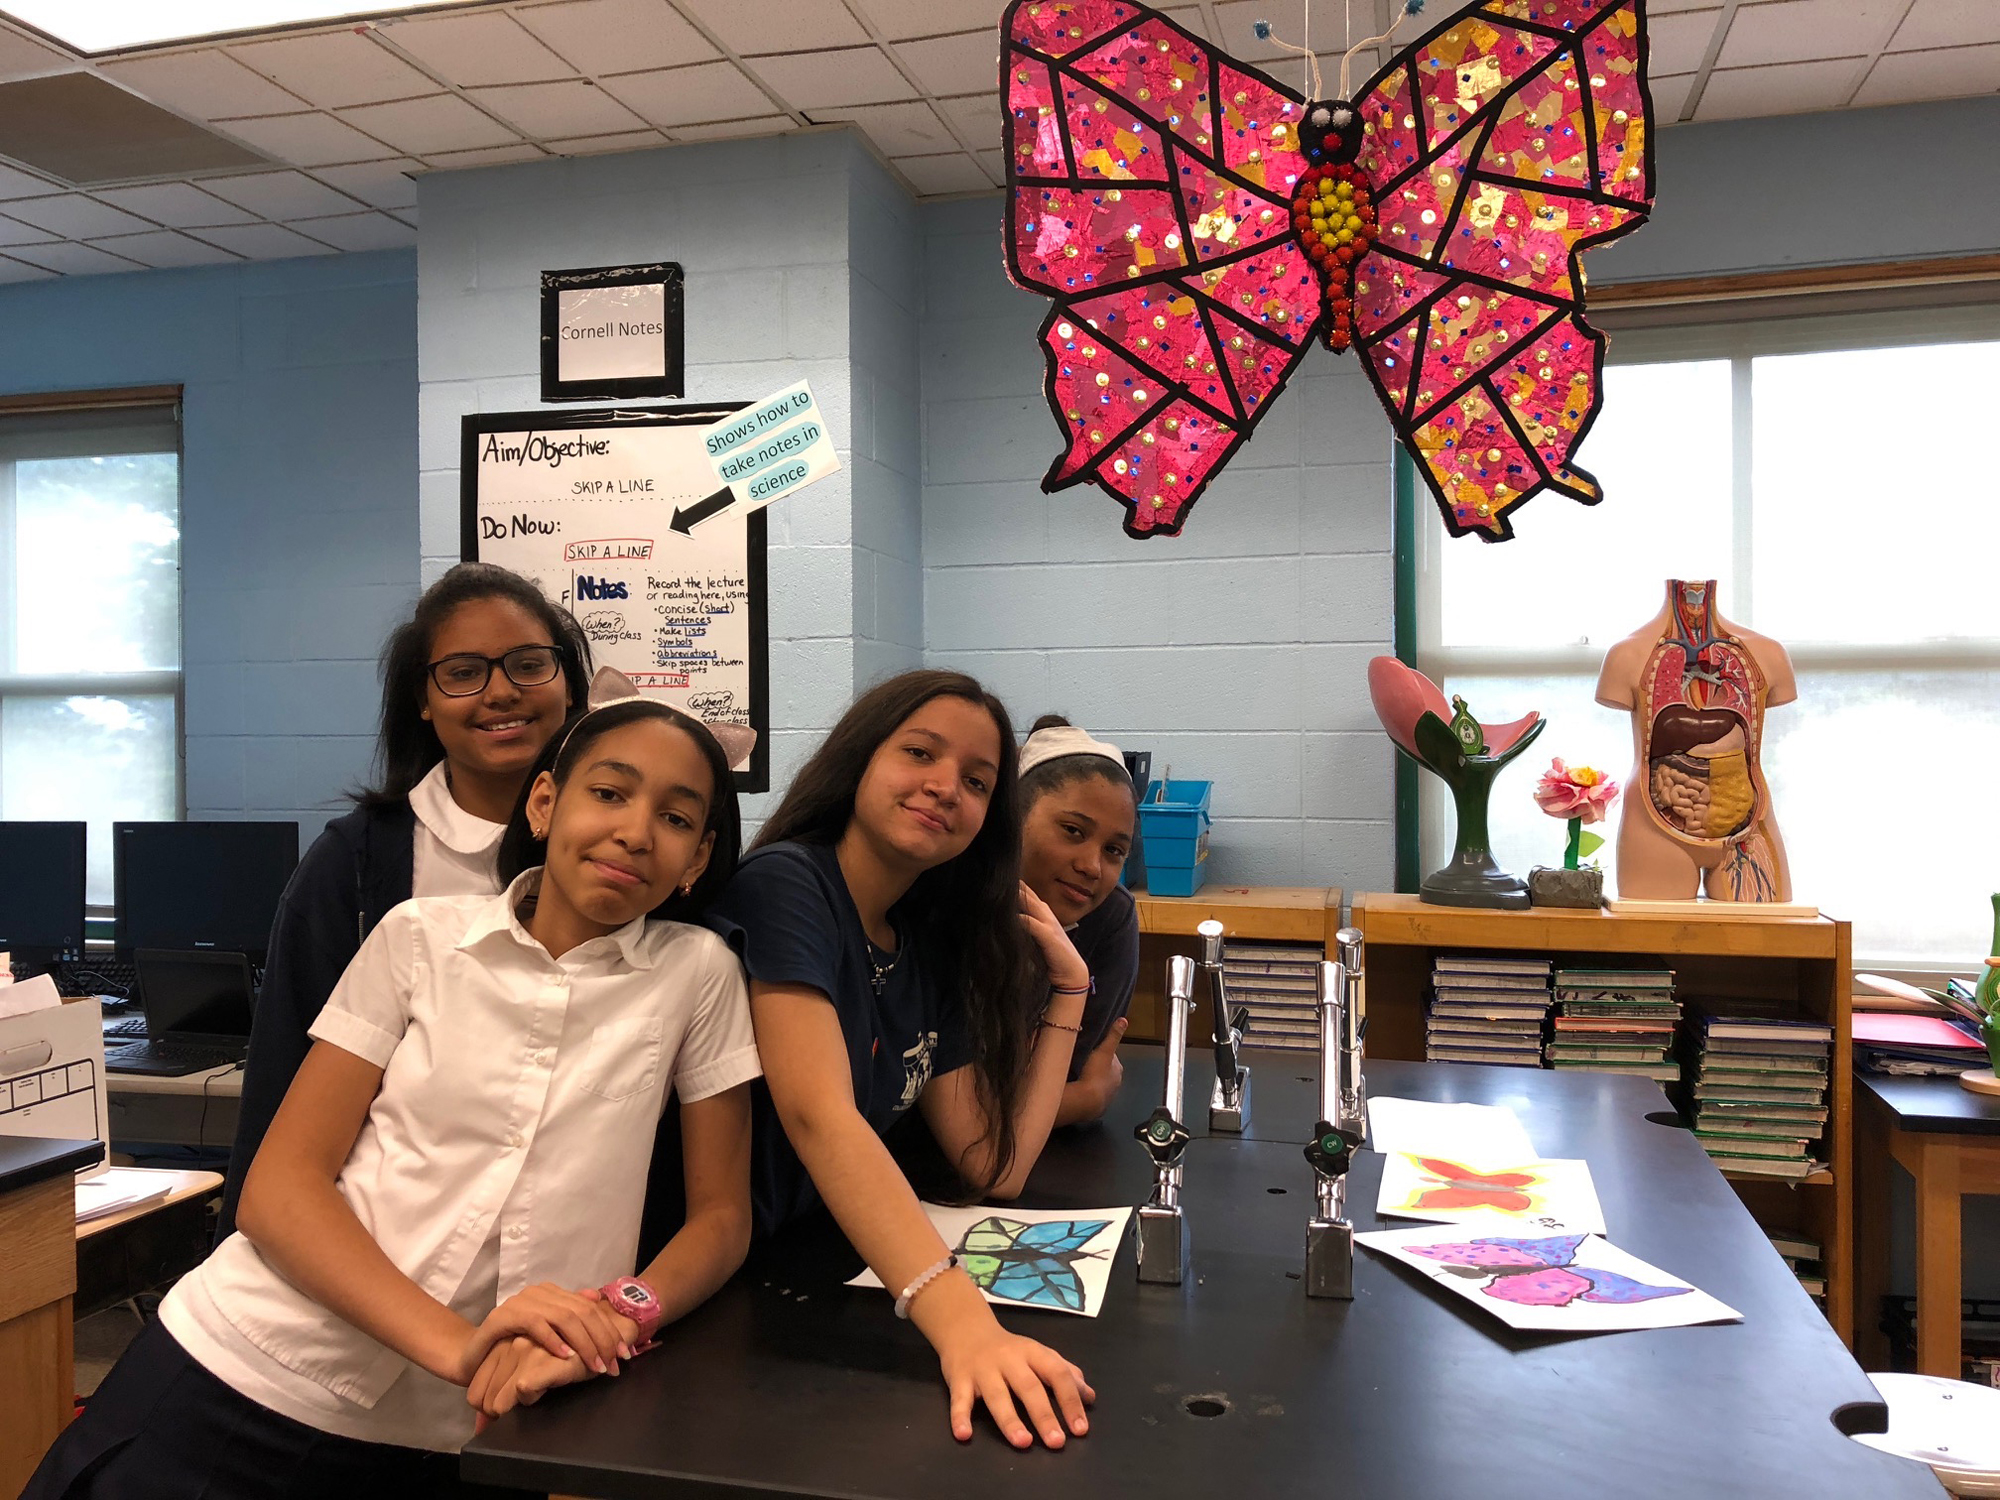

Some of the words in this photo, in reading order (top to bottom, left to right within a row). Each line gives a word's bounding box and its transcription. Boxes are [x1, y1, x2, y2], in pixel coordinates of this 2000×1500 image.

[561, 322, 613, 340] Cornell
[619, 321, 663, 336] Notes
[706, 421, 756, 454] Shows
[755, 401, 790, 427] how
[791, 391, 809, 408] to
[482, 431, 610, 468] Aim/Objective:
[721, 456, 756, 479] take
[758, 433, 801, 462] notes
[801, 426, 819, 441] in
[571, 480, 603, 494] SKIP
[606, 480, 614, 493] A
[618, 478, 655, 494] LINE
[750, 465, 806, 498] science
[480, 516, 507, 539] Do
[511, 513, 561, 538] Now:
[568, 544, 597, 559] SKIP
[603, 545, 611, 558] A
[617, 545, 652, 558] LINE
[647, 576, 682, 589] Record
[684, 576, 702, 589] the
[707, 575, 745, 590] lecture
[646, 592, 658, 600] or
[663, 589, 700, 604] reading
[700, 590, 724, 601] here,
[591, 630, 618, 645] During
[660, 627, 682, 635] Make
[658, 637, 693, 647] Symbols
[680, 660, 708, 668] spaces
[712, 657, 744, 667] between
[680, 667, 707, 676] points
[648, 675, 657, 685] A
[663, 675, 687, 685] LINE
[1326, 1139, 1338, 1149] CW
